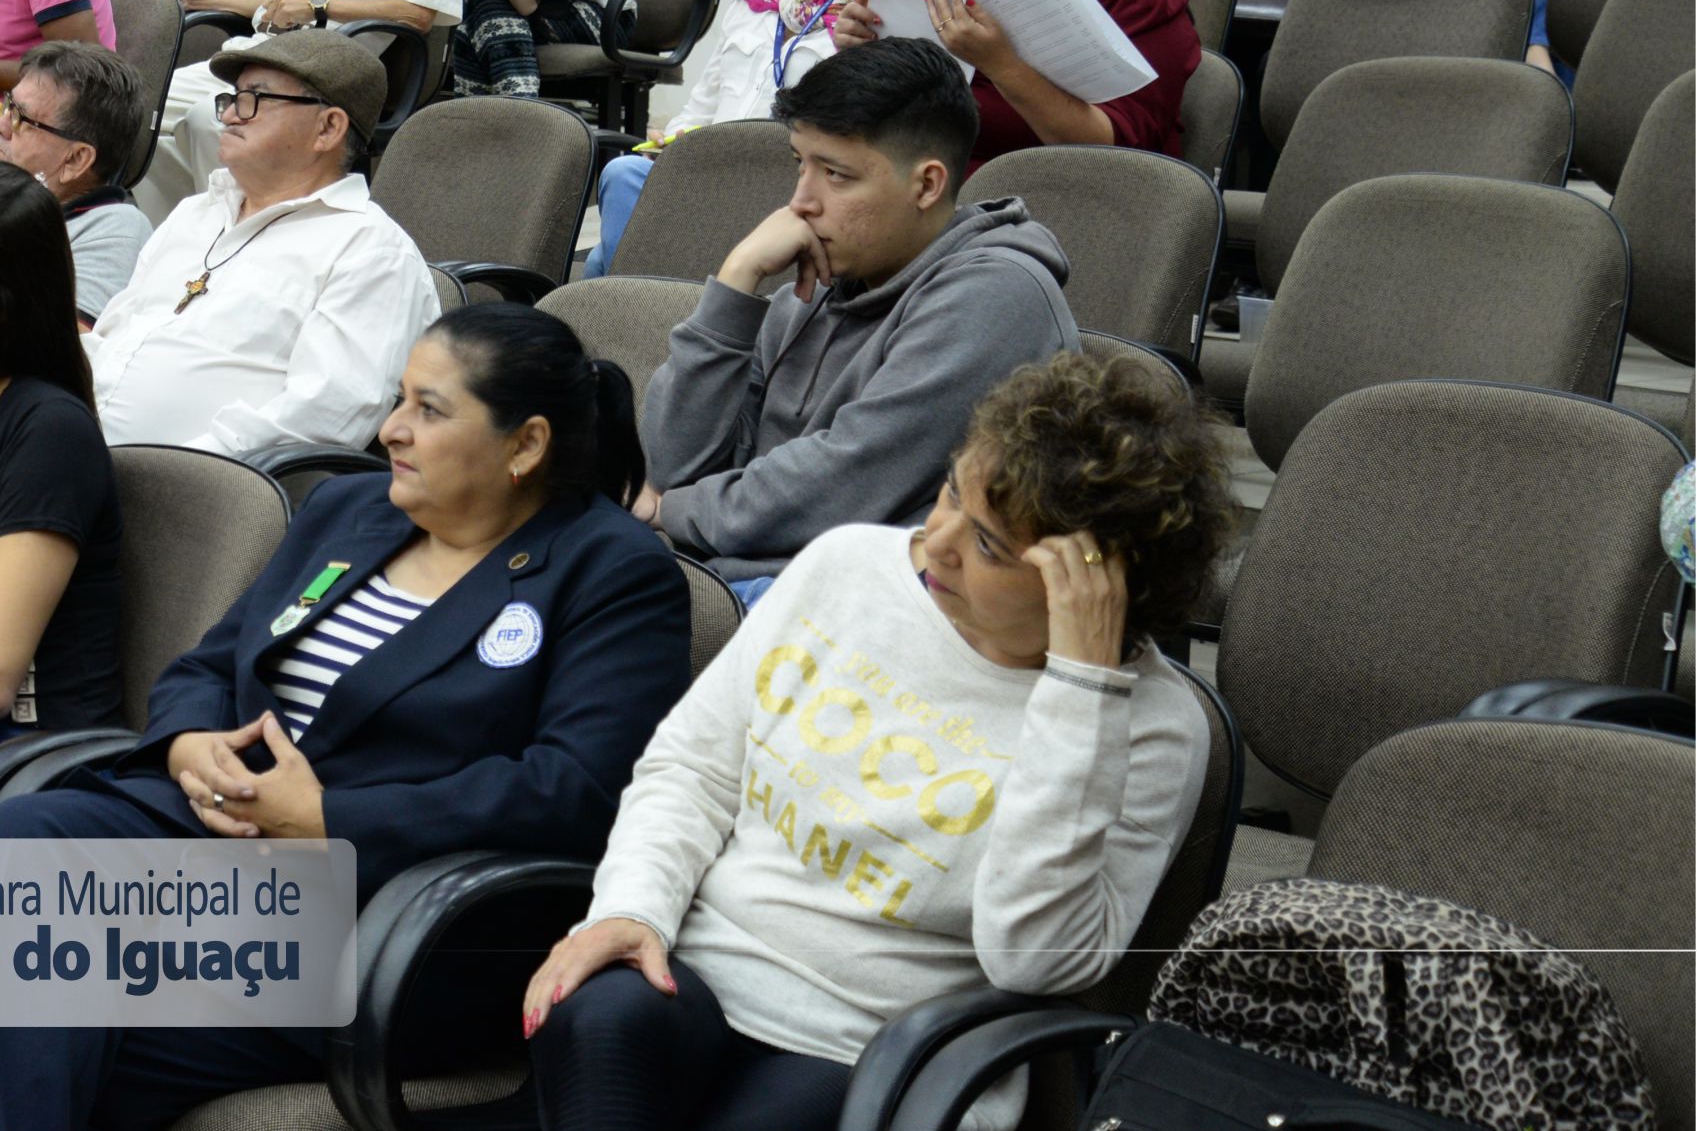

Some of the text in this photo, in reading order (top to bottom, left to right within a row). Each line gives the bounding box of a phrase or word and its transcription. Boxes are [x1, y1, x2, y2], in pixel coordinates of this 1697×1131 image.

[497, 628, 523, 642] FIEP
[755, 643, 996, 837] COCO
[894, 691, 944, 726] are
[936, 716, 988, 756] the
[746, 768, 917, 928] HANEL
